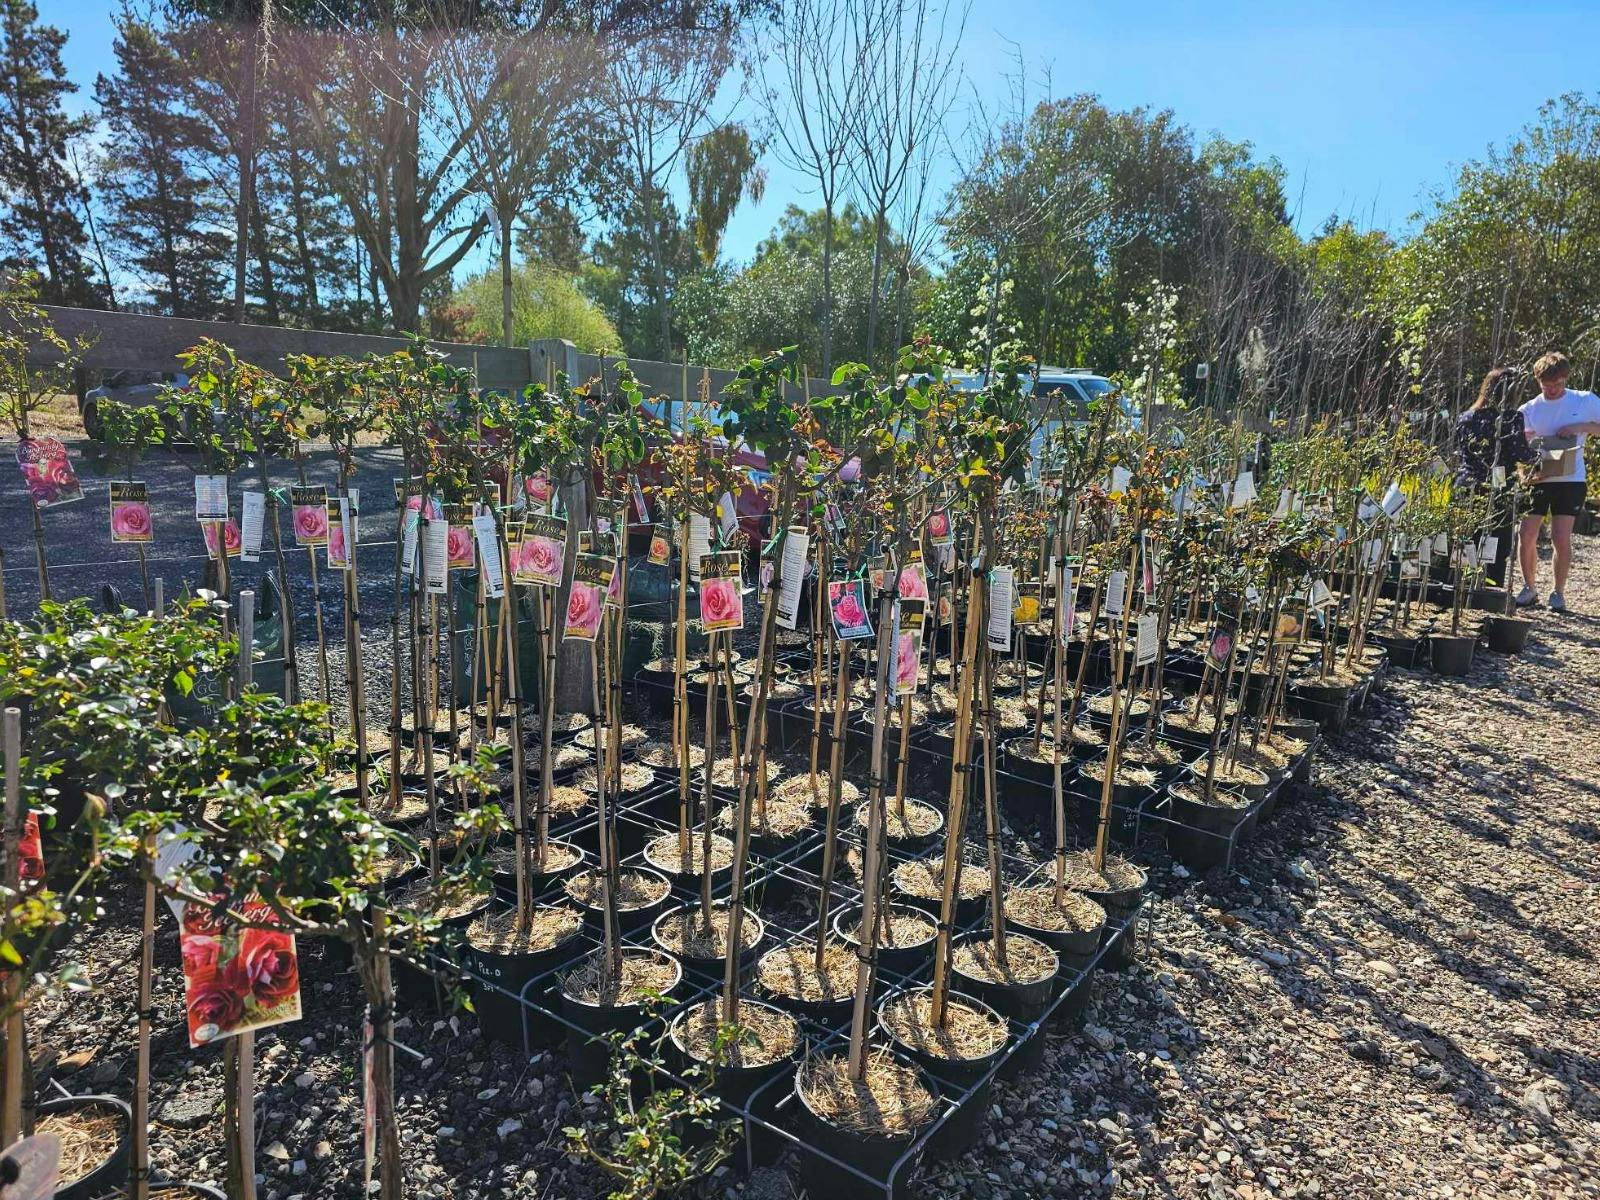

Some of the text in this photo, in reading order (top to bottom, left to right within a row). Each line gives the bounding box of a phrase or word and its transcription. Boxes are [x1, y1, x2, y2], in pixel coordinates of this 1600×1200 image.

[534, 518, 560, 533] Rose
[575, 560, 600, 579] Rose
[704, 559, 728, 573] Rose
